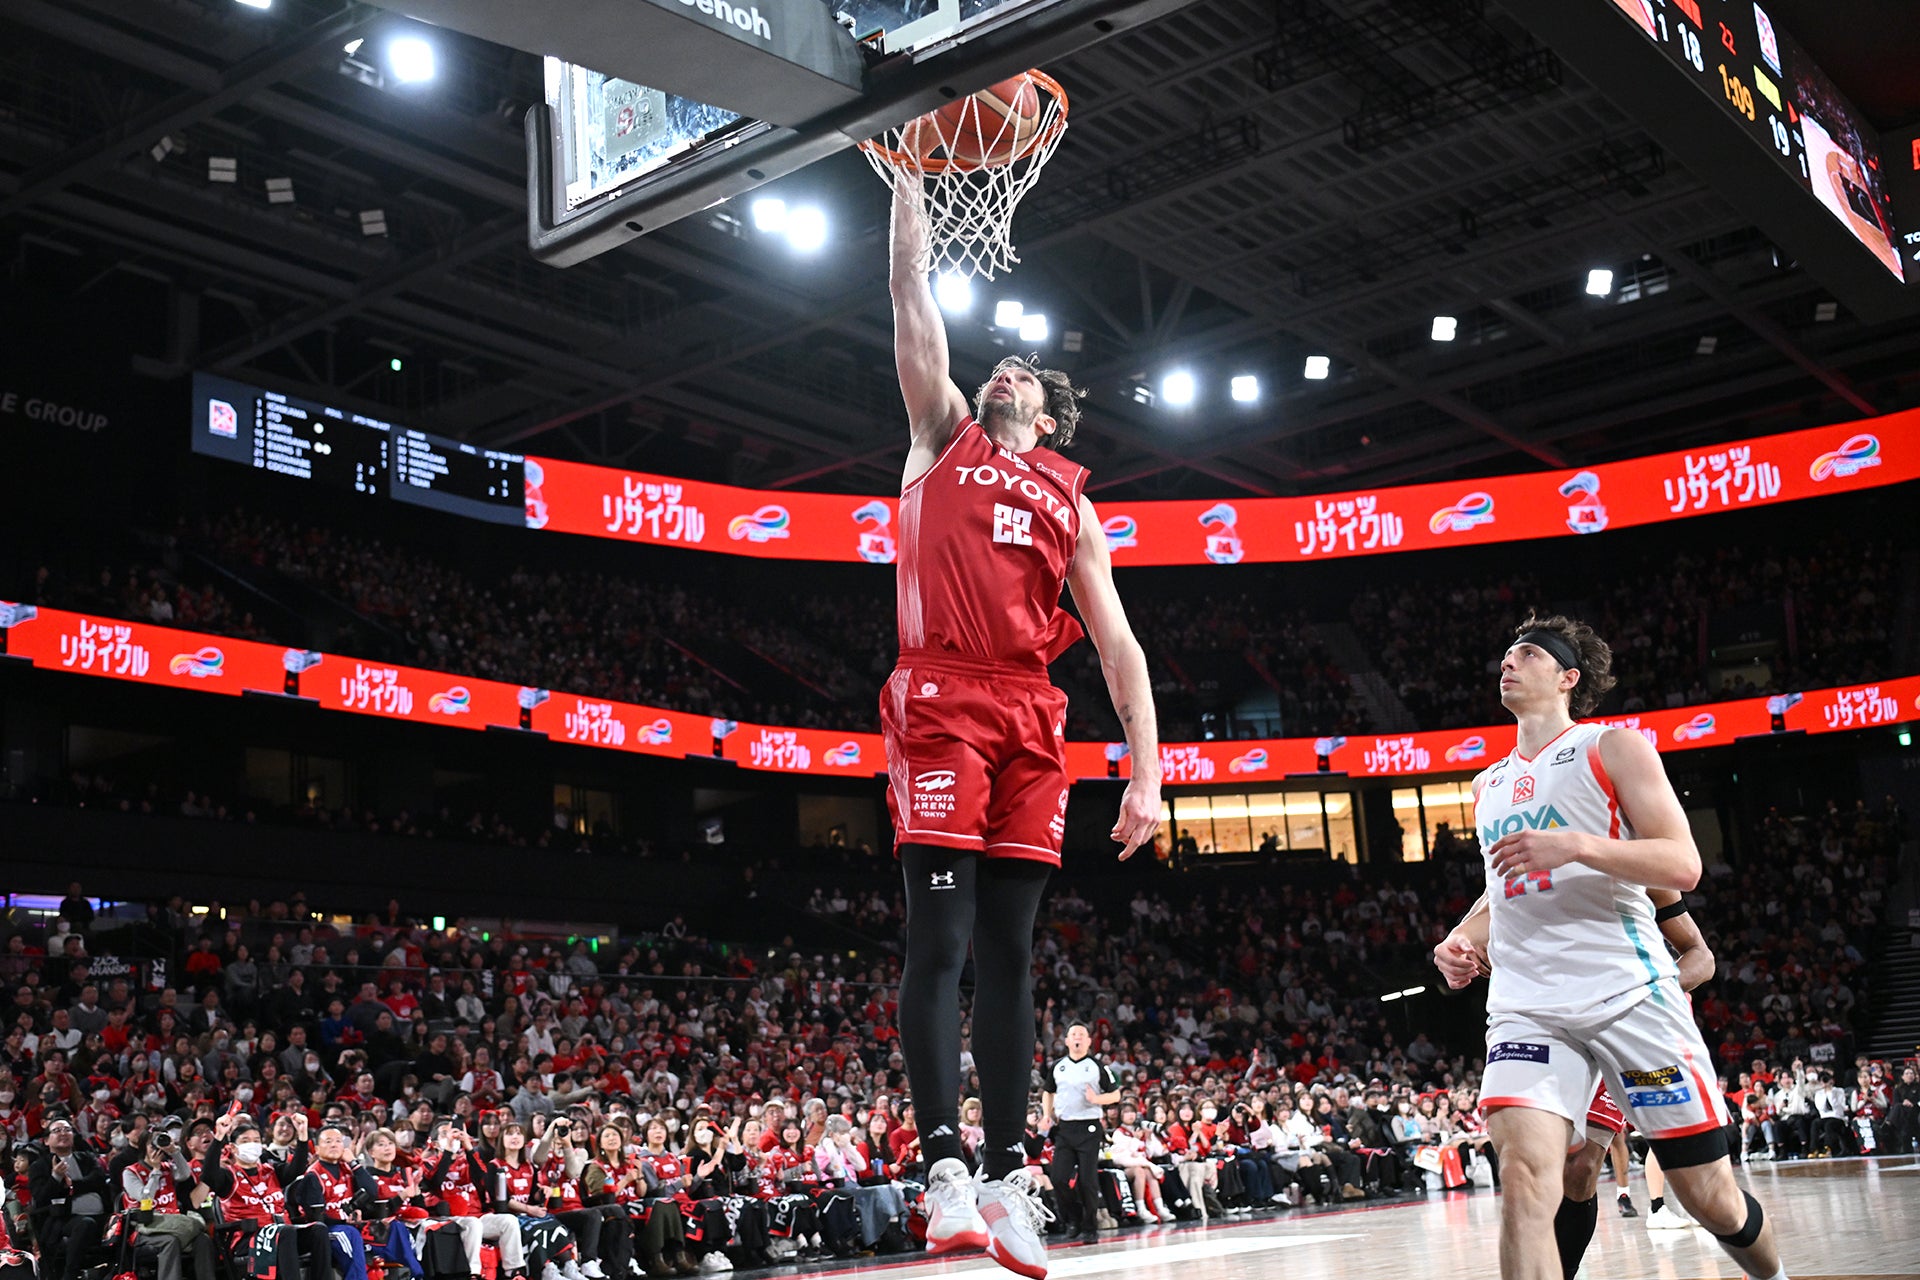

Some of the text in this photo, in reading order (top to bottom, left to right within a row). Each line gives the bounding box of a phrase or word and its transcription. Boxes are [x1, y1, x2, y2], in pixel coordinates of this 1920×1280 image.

[678, 0, 771, 41] enoh
[1677, 22, 1704, 72] 18
[1718, 63, 1756, 121] 1:09
[1768, 114, 1790, 156] 19
[24, 398, 108, 432] GROUP
[1684, 445, 1751, 476] レッツ
[624, 476, 682, 502] レッツ
[955, 464, 1072, 532] TOYOTA
[1663, 462, 1781, 513] リサイクル
[602, 495, 705, 542] リサイクル
[1315, 496, 1377, 520] レッツ
[993, 503, 1033, 546] 22
[1295, 513, 1404, 555] リサイクル
[80, 619, 132, 641] レッツ
[60, 634, 149, 677] リサイクル
[356, 664, 399, 682] レッツ
[340, 677, 413, 715] リサイクル
[577, 699, 612, 717] レッツ
[1837, 686, 1879, 705] レッツ
[1824, 697, 1898, 728] リサイクル
[565, 712, 625, 746] リサイクル
[1375, 736, 1414, 753] レッツ
[1364, 746, 1430, 774] リサイクル
[913, 802, 955, 811] ARENA
[914, 793, 955, 802] TOYOTA
[1483, 804, 1569, 847] NOVA
[87, 963, 131, 977] ARANSKI
[1494, 1050, 1533, 1060] Engineer
